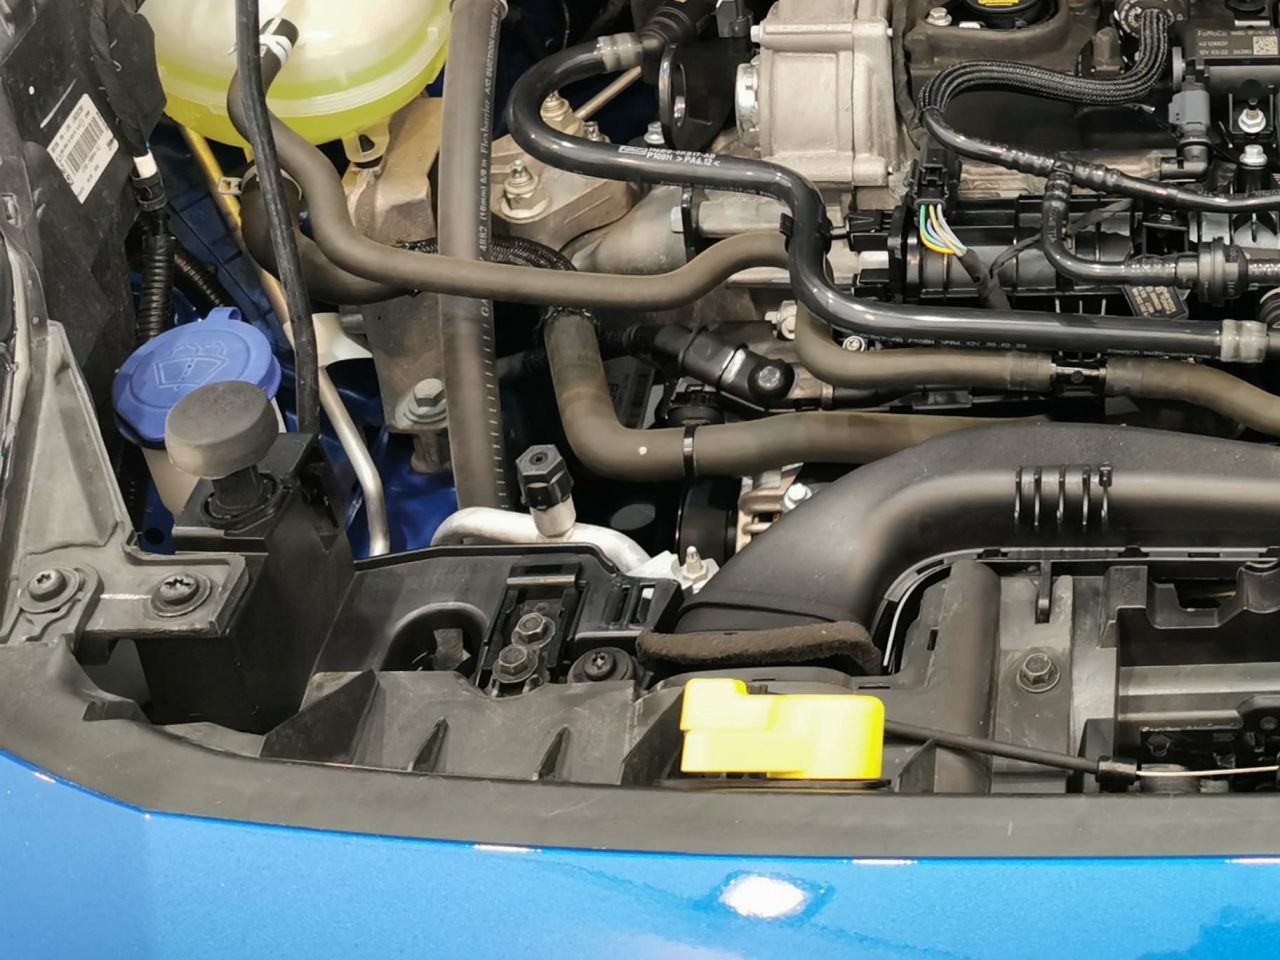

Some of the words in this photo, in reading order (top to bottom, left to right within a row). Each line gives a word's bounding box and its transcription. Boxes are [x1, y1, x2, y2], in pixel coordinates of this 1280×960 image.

[489, 13, 499, 40] HOSE
[486, 38, 495, 79] SUCTION
[480, 99, 491, 154] Flexbarrier
